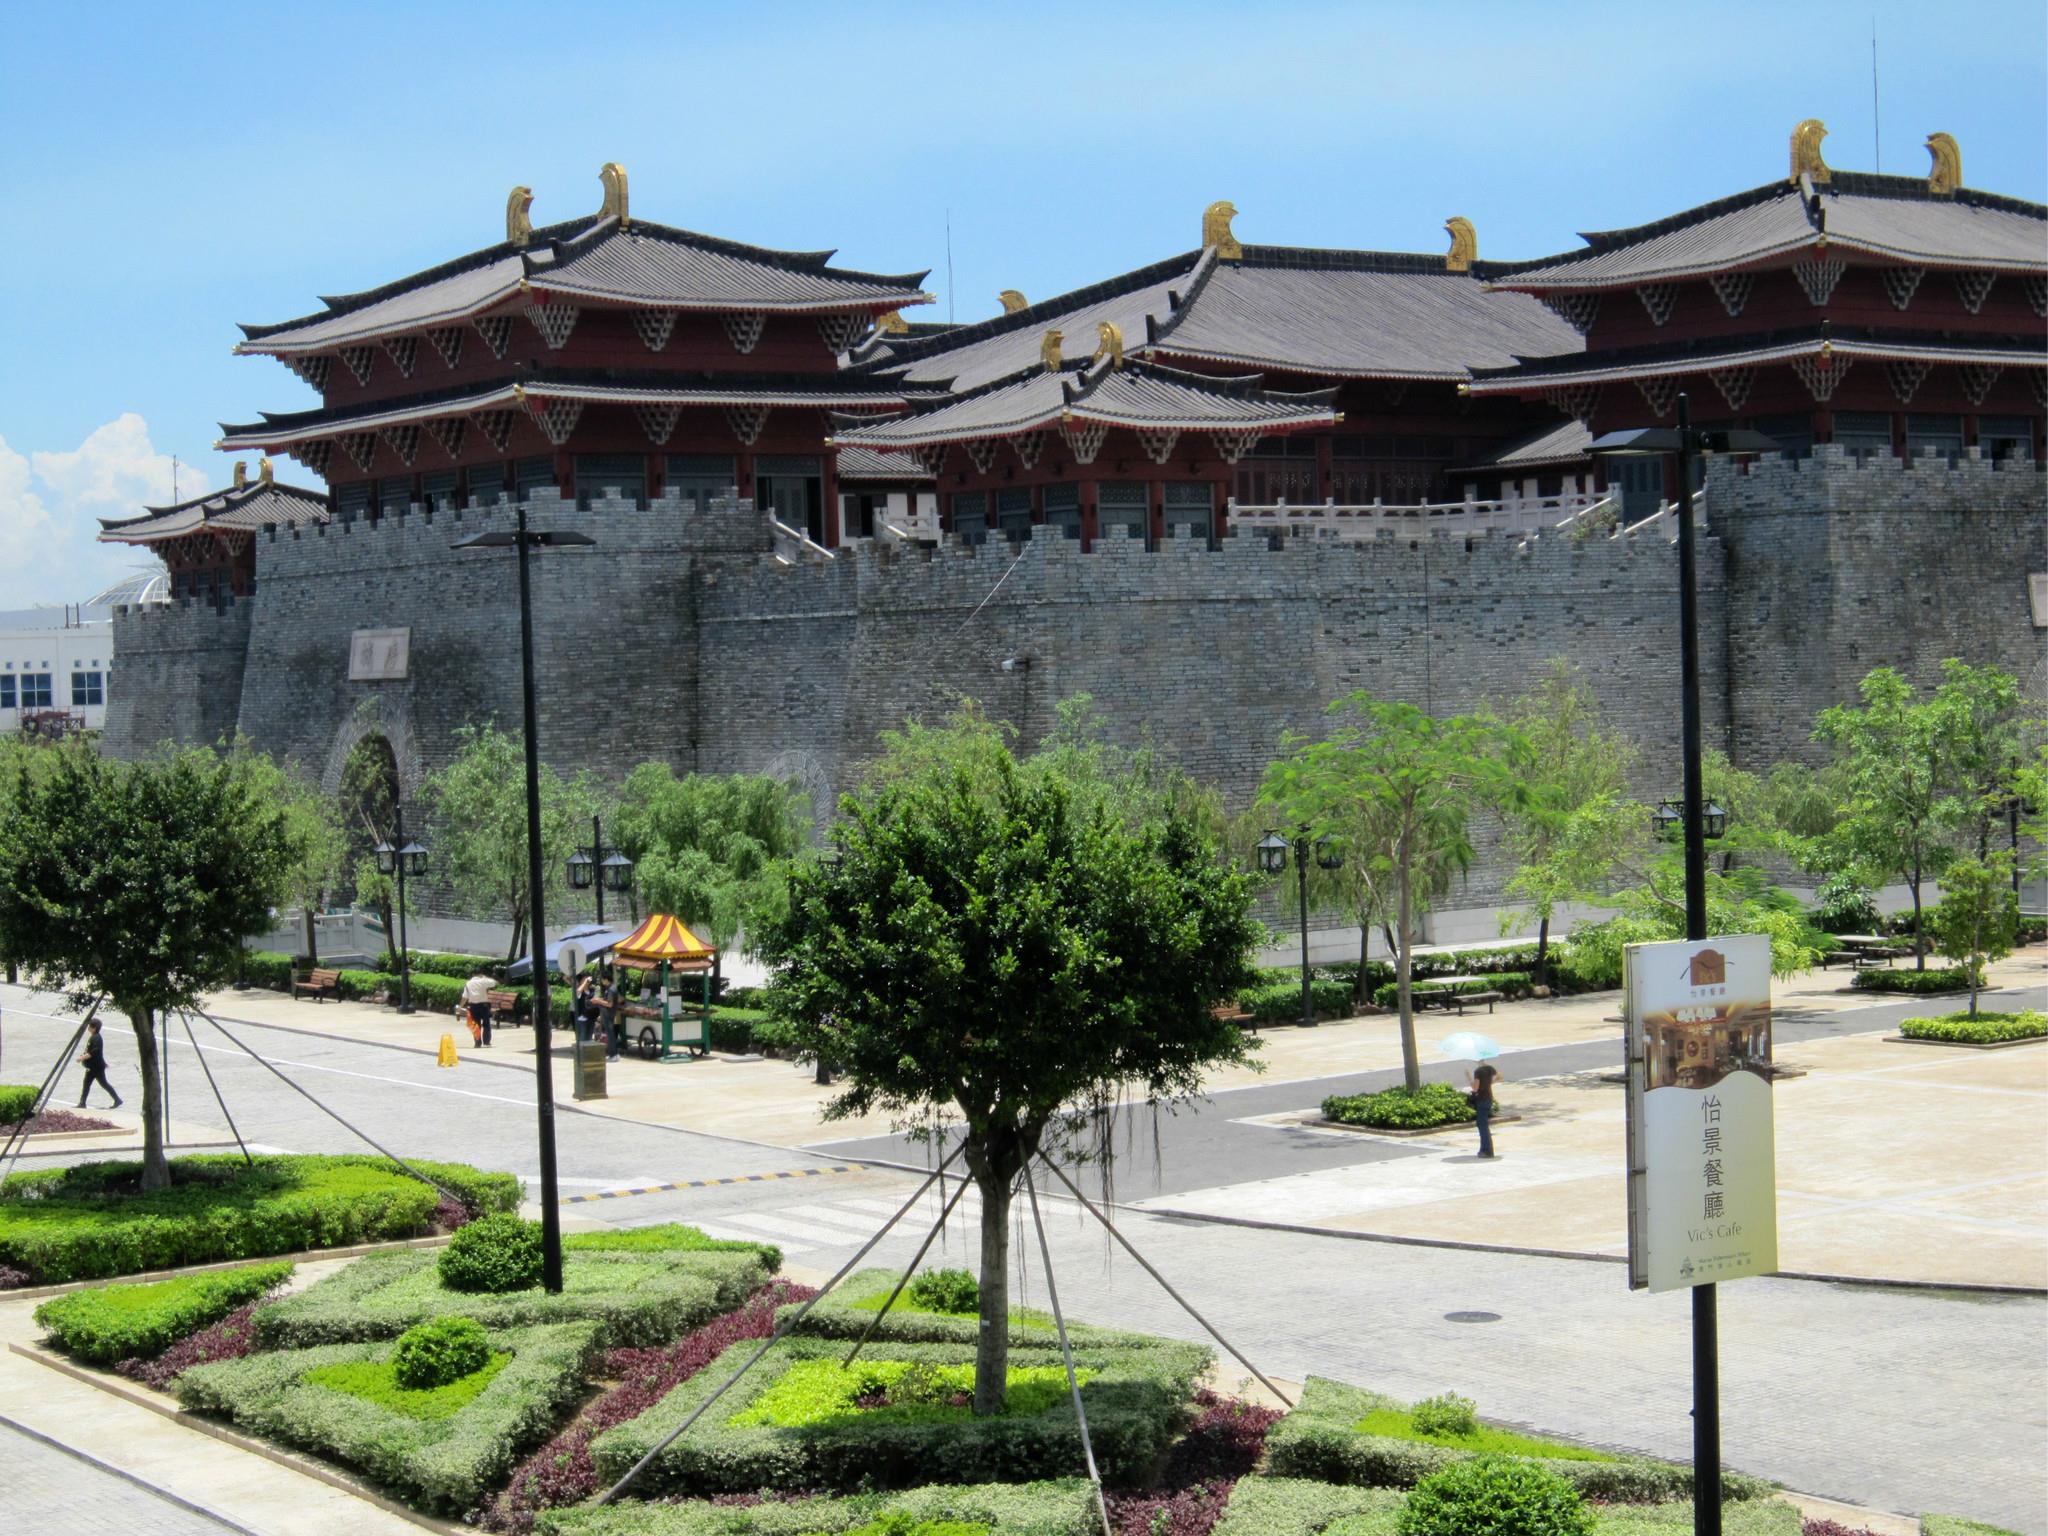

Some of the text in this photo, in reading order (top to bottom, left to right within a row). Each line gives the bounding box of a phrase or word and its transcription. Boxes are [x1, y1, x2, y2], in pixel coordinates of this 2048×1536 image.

[1701, 1094, 1724, 1220] 怡景餐廳
[1687, 1226, 1713, 1242] Vic's
